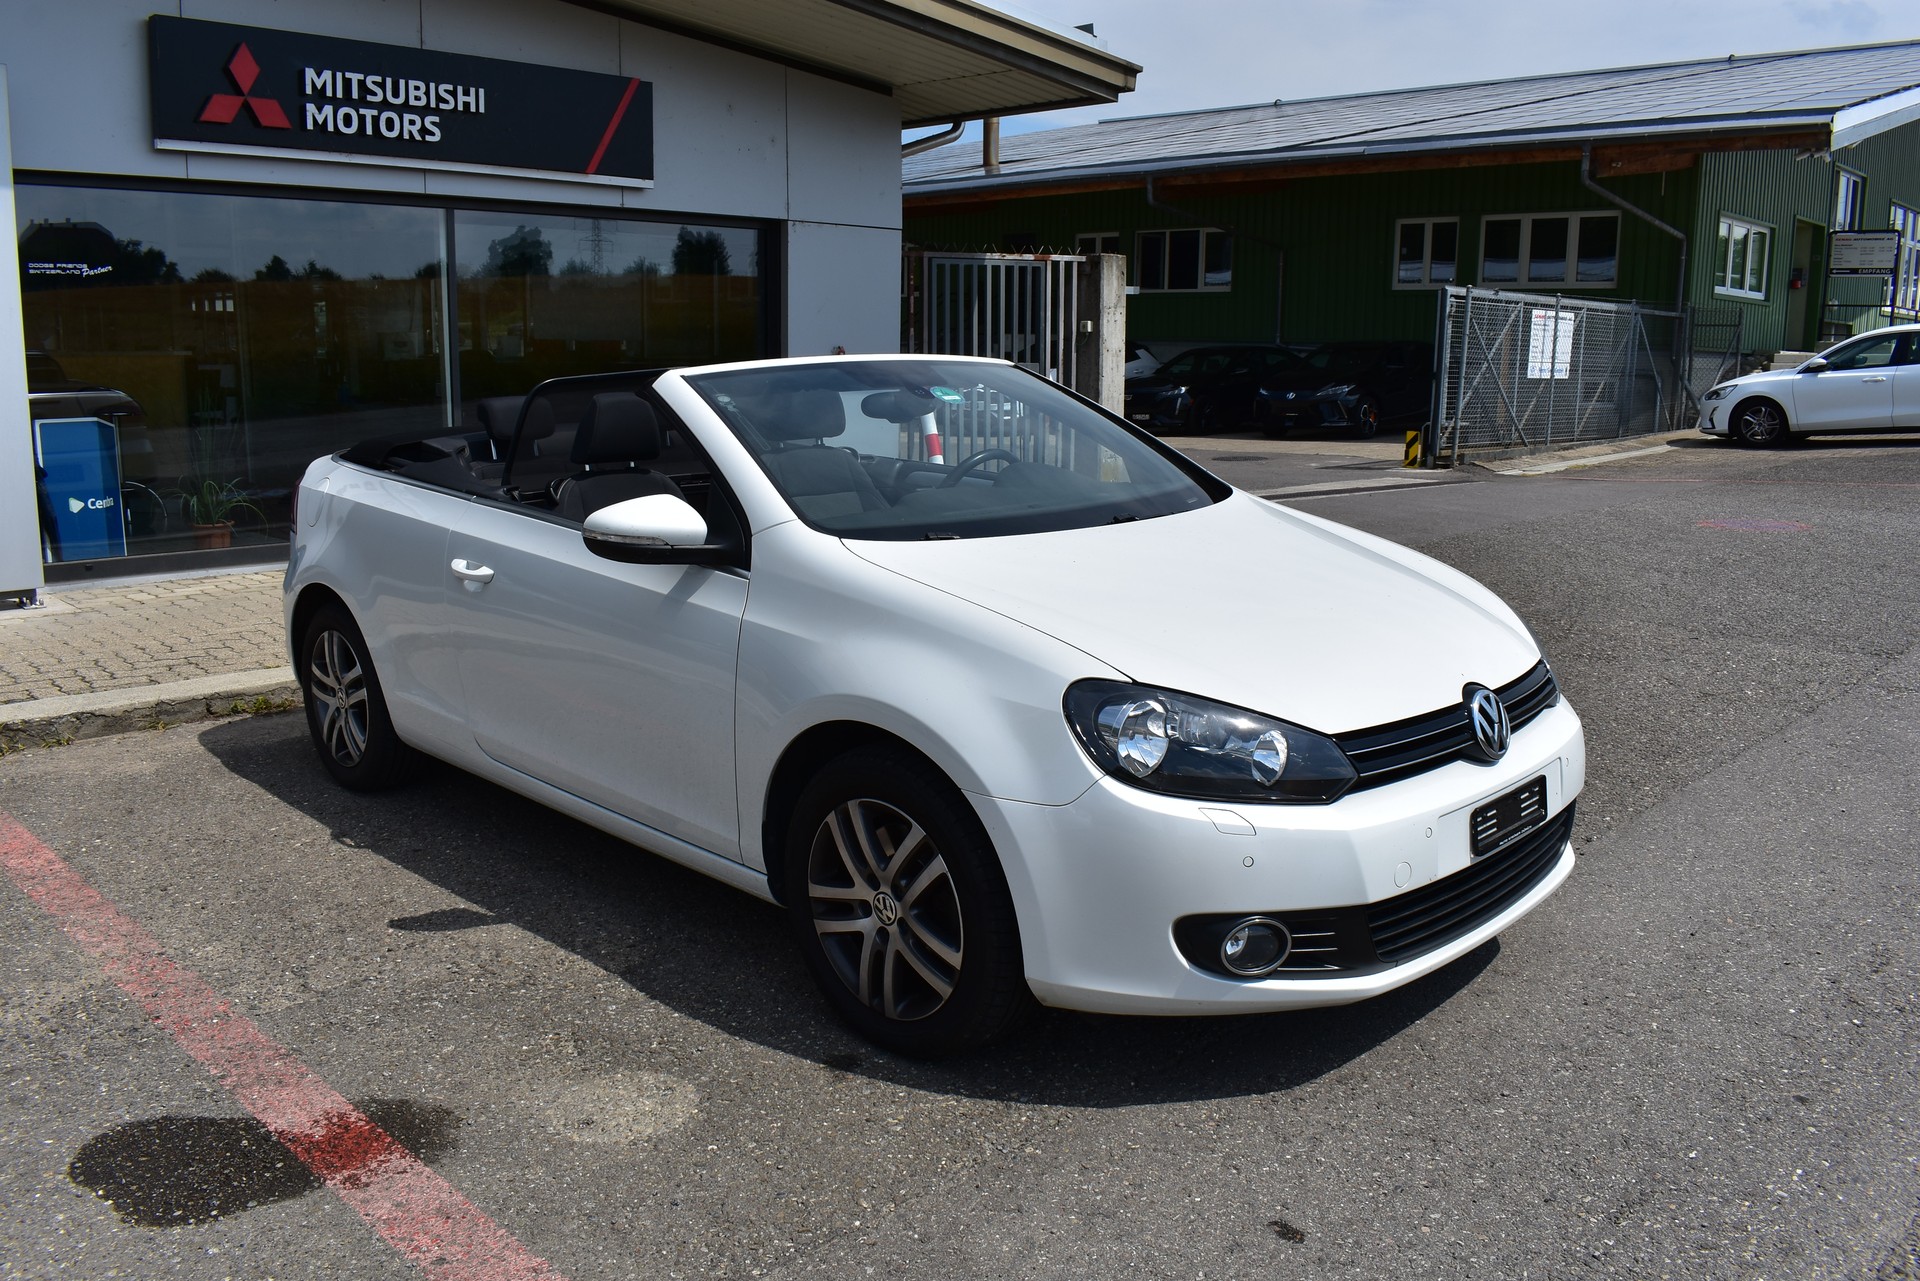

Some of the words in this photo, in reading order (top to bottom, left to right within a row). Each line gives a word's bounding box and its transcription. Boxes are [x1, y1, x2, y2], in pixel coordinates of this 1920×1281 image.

[305, 67, 485, 113] MITSUBISHI
[305, 104, 441, 141] MOTORS
[81, 265, 113, 278] Partner
